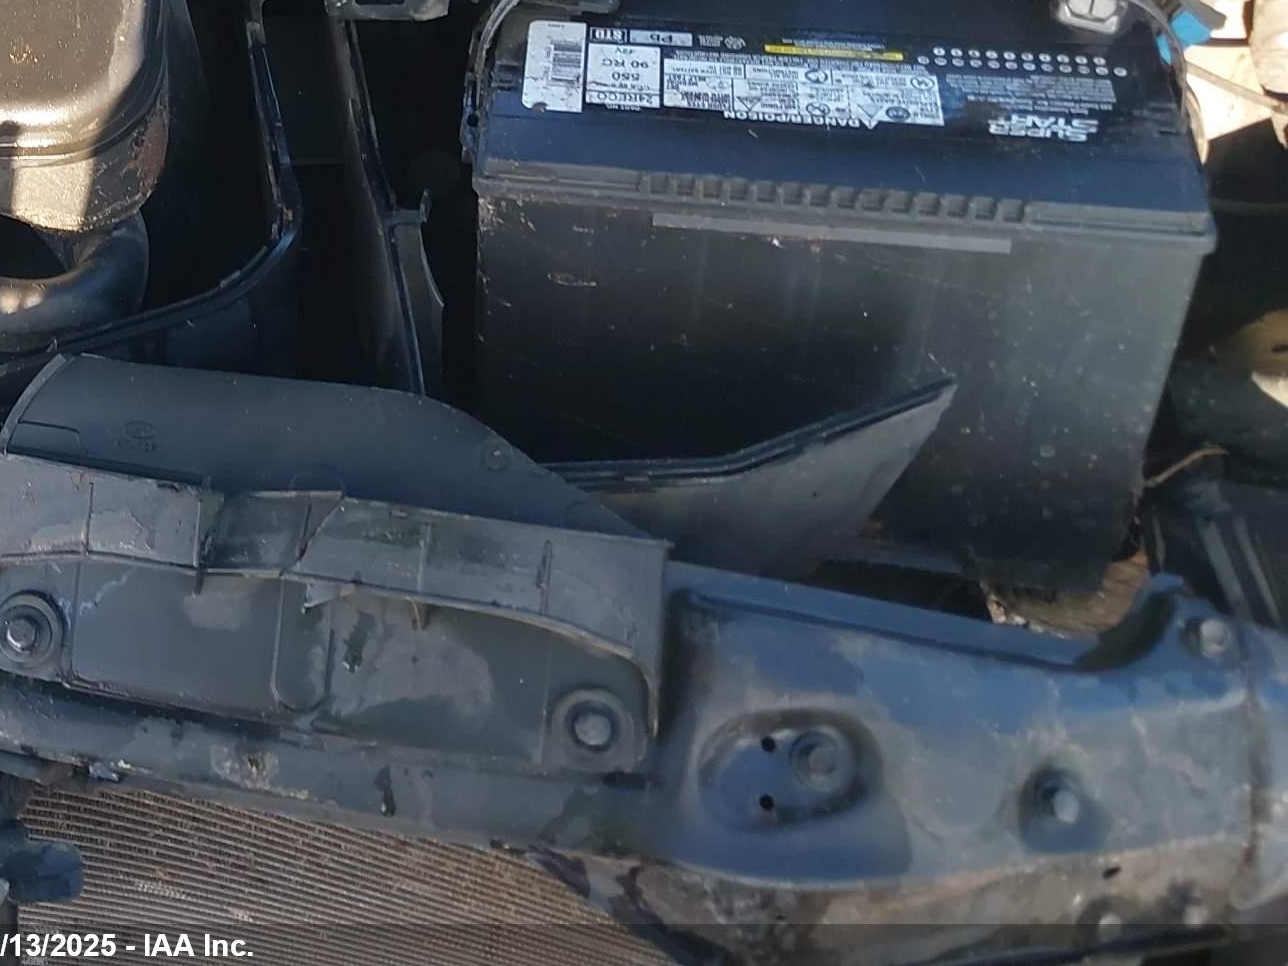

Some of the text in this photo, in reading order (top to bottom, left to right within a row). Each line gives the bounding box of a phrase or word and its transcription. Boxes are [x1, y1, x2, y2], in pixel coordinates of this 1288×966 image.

[650, 33, 673, 43] Pb
[630, 60, 649, 69] 90
[611, 72, 640, 82] 550
[724, 111, 861, 128] DANGER/POISON
[988, 115, 1099, 133] START
[989, 125, 1088, 142] SUPER
